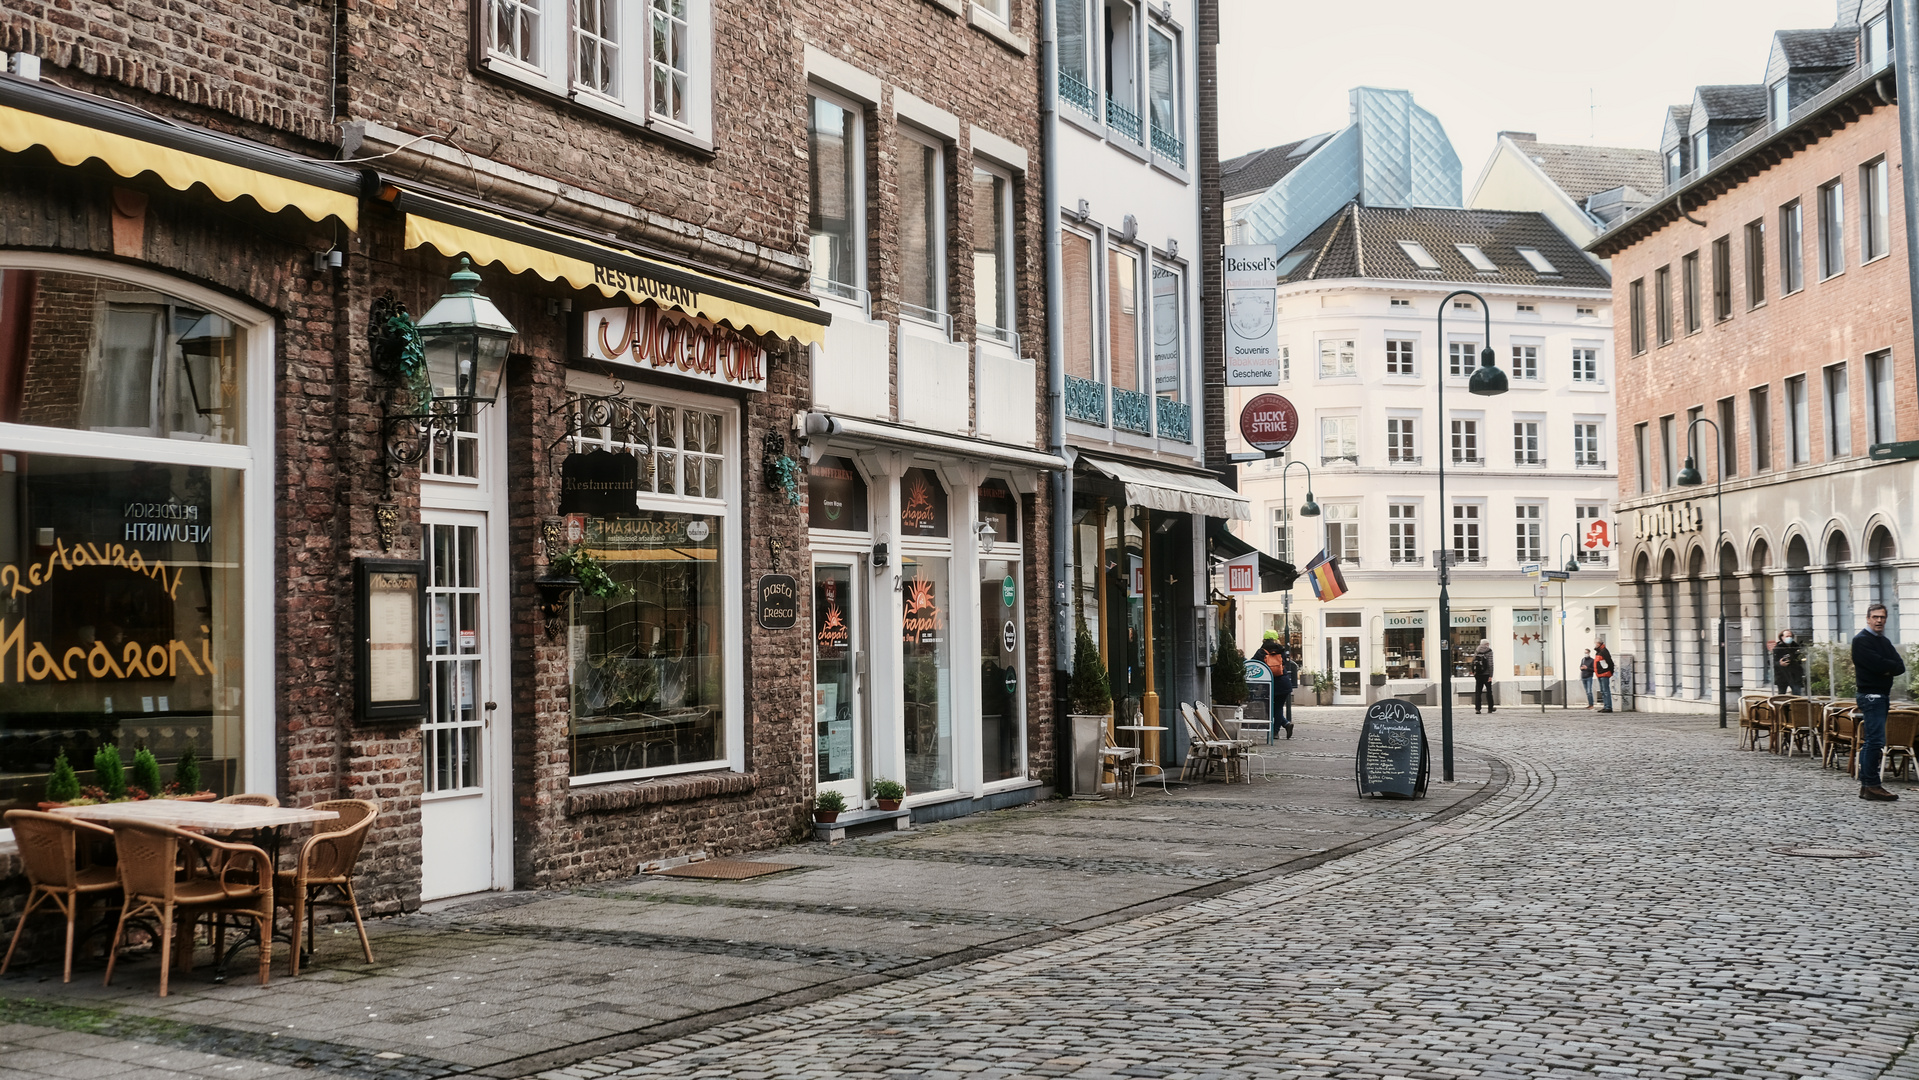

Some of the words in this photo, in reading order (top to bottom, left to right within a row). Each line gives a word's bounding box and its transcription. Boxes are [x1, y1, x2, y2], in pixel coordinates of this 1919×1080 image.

[1227, 257, 1276, 272] Beissel's
[593, 264, 700, 309] RESTAURANT
[1234, 346, 1270, 355] Souvenirs
[1228, 356, 1278, 367] Tabakwaren
[1232, 369, 1273, 379] Geschenke
[1253, 411, 1286, 422] LUCKY
[1251, 421, 1287, 433] STRIKE
[565, 475, 634, 492] Restaurant
[902, 500, 935, 528] chapati
[1, 537, 183, 600] Restaurant
[370, 574, 417, 590] Macaroni
[1231, 568, 1252, 589] Bild
[763, 581, 793, 601] pasta
[763, 607, 794, 619] fresca
[1389, 615, 1423, 625] 100Tee
[1453, 614, 1487, 624] 100Tee
[818, 623, 848, 647] chapati
[0, 617, 218, 683] Macaroni
[1394, 703, 1419, 723] Dom
